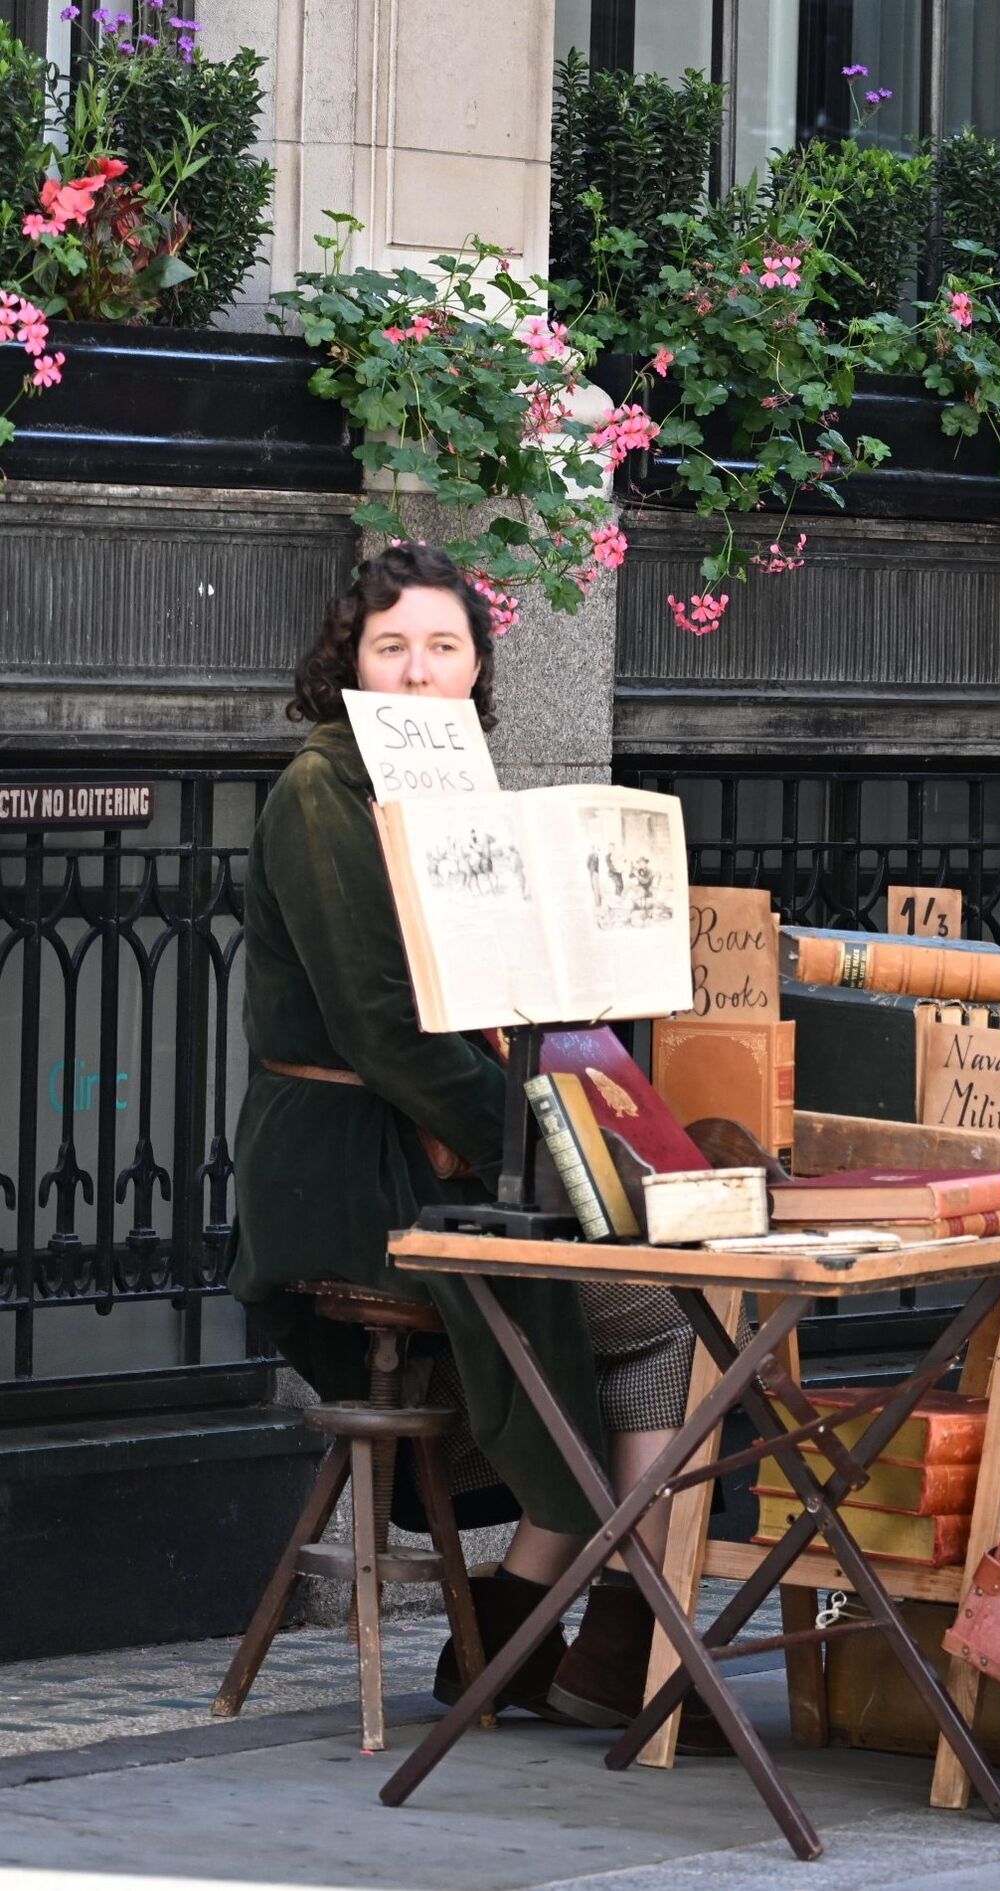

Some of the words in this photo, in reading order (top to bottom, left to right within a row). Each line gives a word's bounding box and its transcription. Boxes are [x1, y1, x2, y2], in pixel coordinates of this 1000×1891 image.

[376, 706, 465, 750] SALE
[379, 762, 475, 792] BOOKS
[0, 789, 38, 818] CTLY
[42, 789, 64, 818] NO
[68, 787, 150, 817] LOITERING
[689, 905, 766, 954] Rare
[686, 964, 769, 1017] Books
